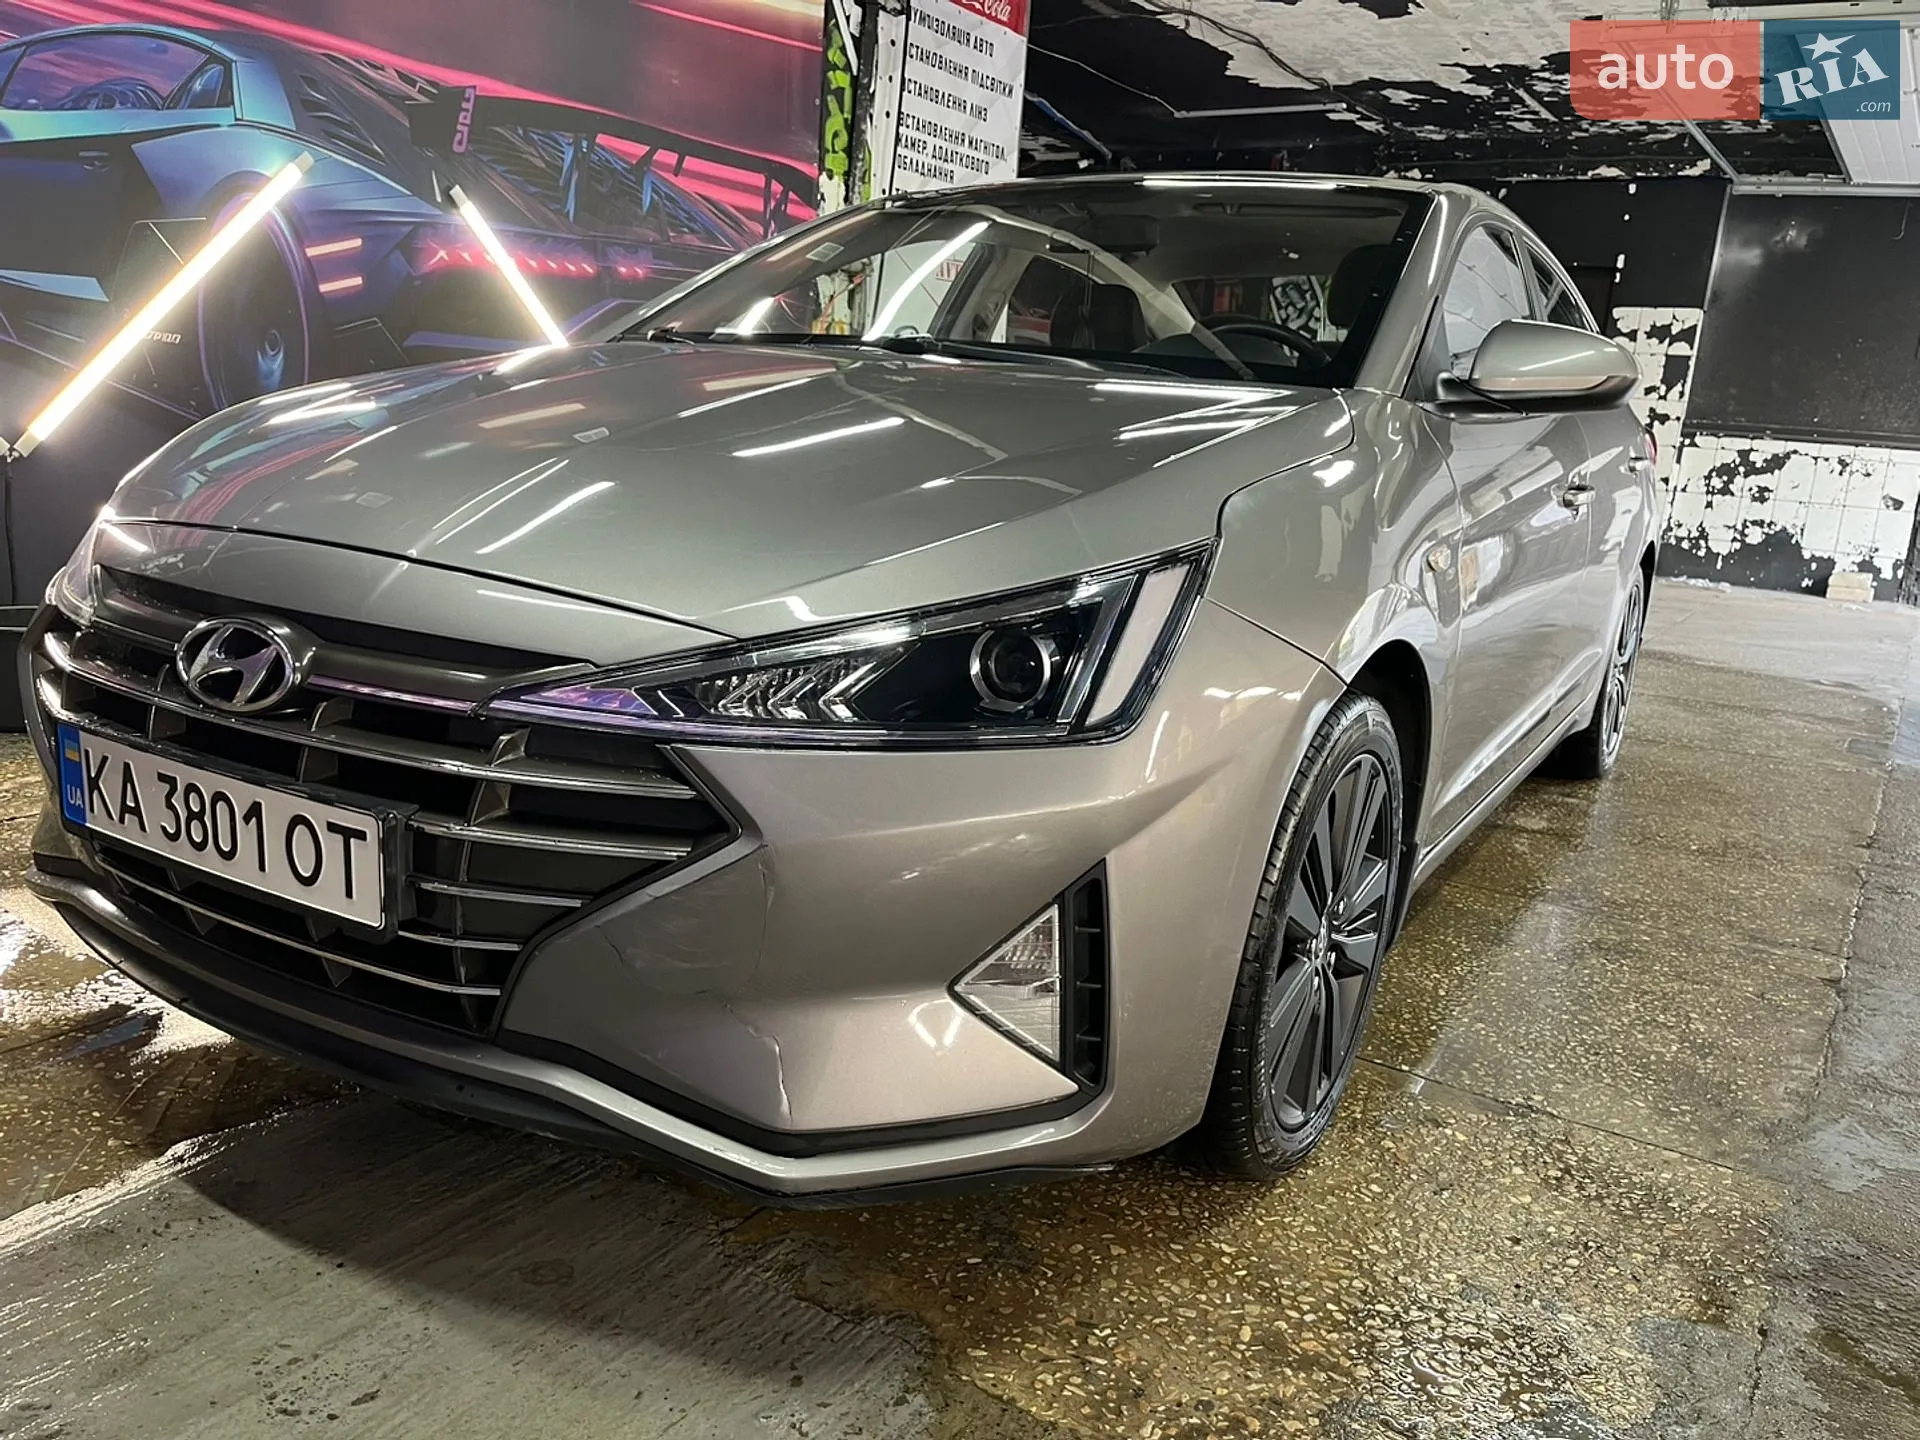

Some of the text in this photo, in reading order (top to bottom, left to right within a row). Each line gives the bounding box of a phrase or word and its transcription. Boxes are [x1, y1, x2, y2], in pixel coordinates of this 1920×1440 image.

[907, 42, 969, 82] СТАНОВЛЕННЯ
[973, 35, 995, 58] АВТО
[897, 153, 955, 185] ОБЛАДНАННЯ
[66, 783, 85, 809] UA
[83, 747, 368, 900] KA 3801 OT
